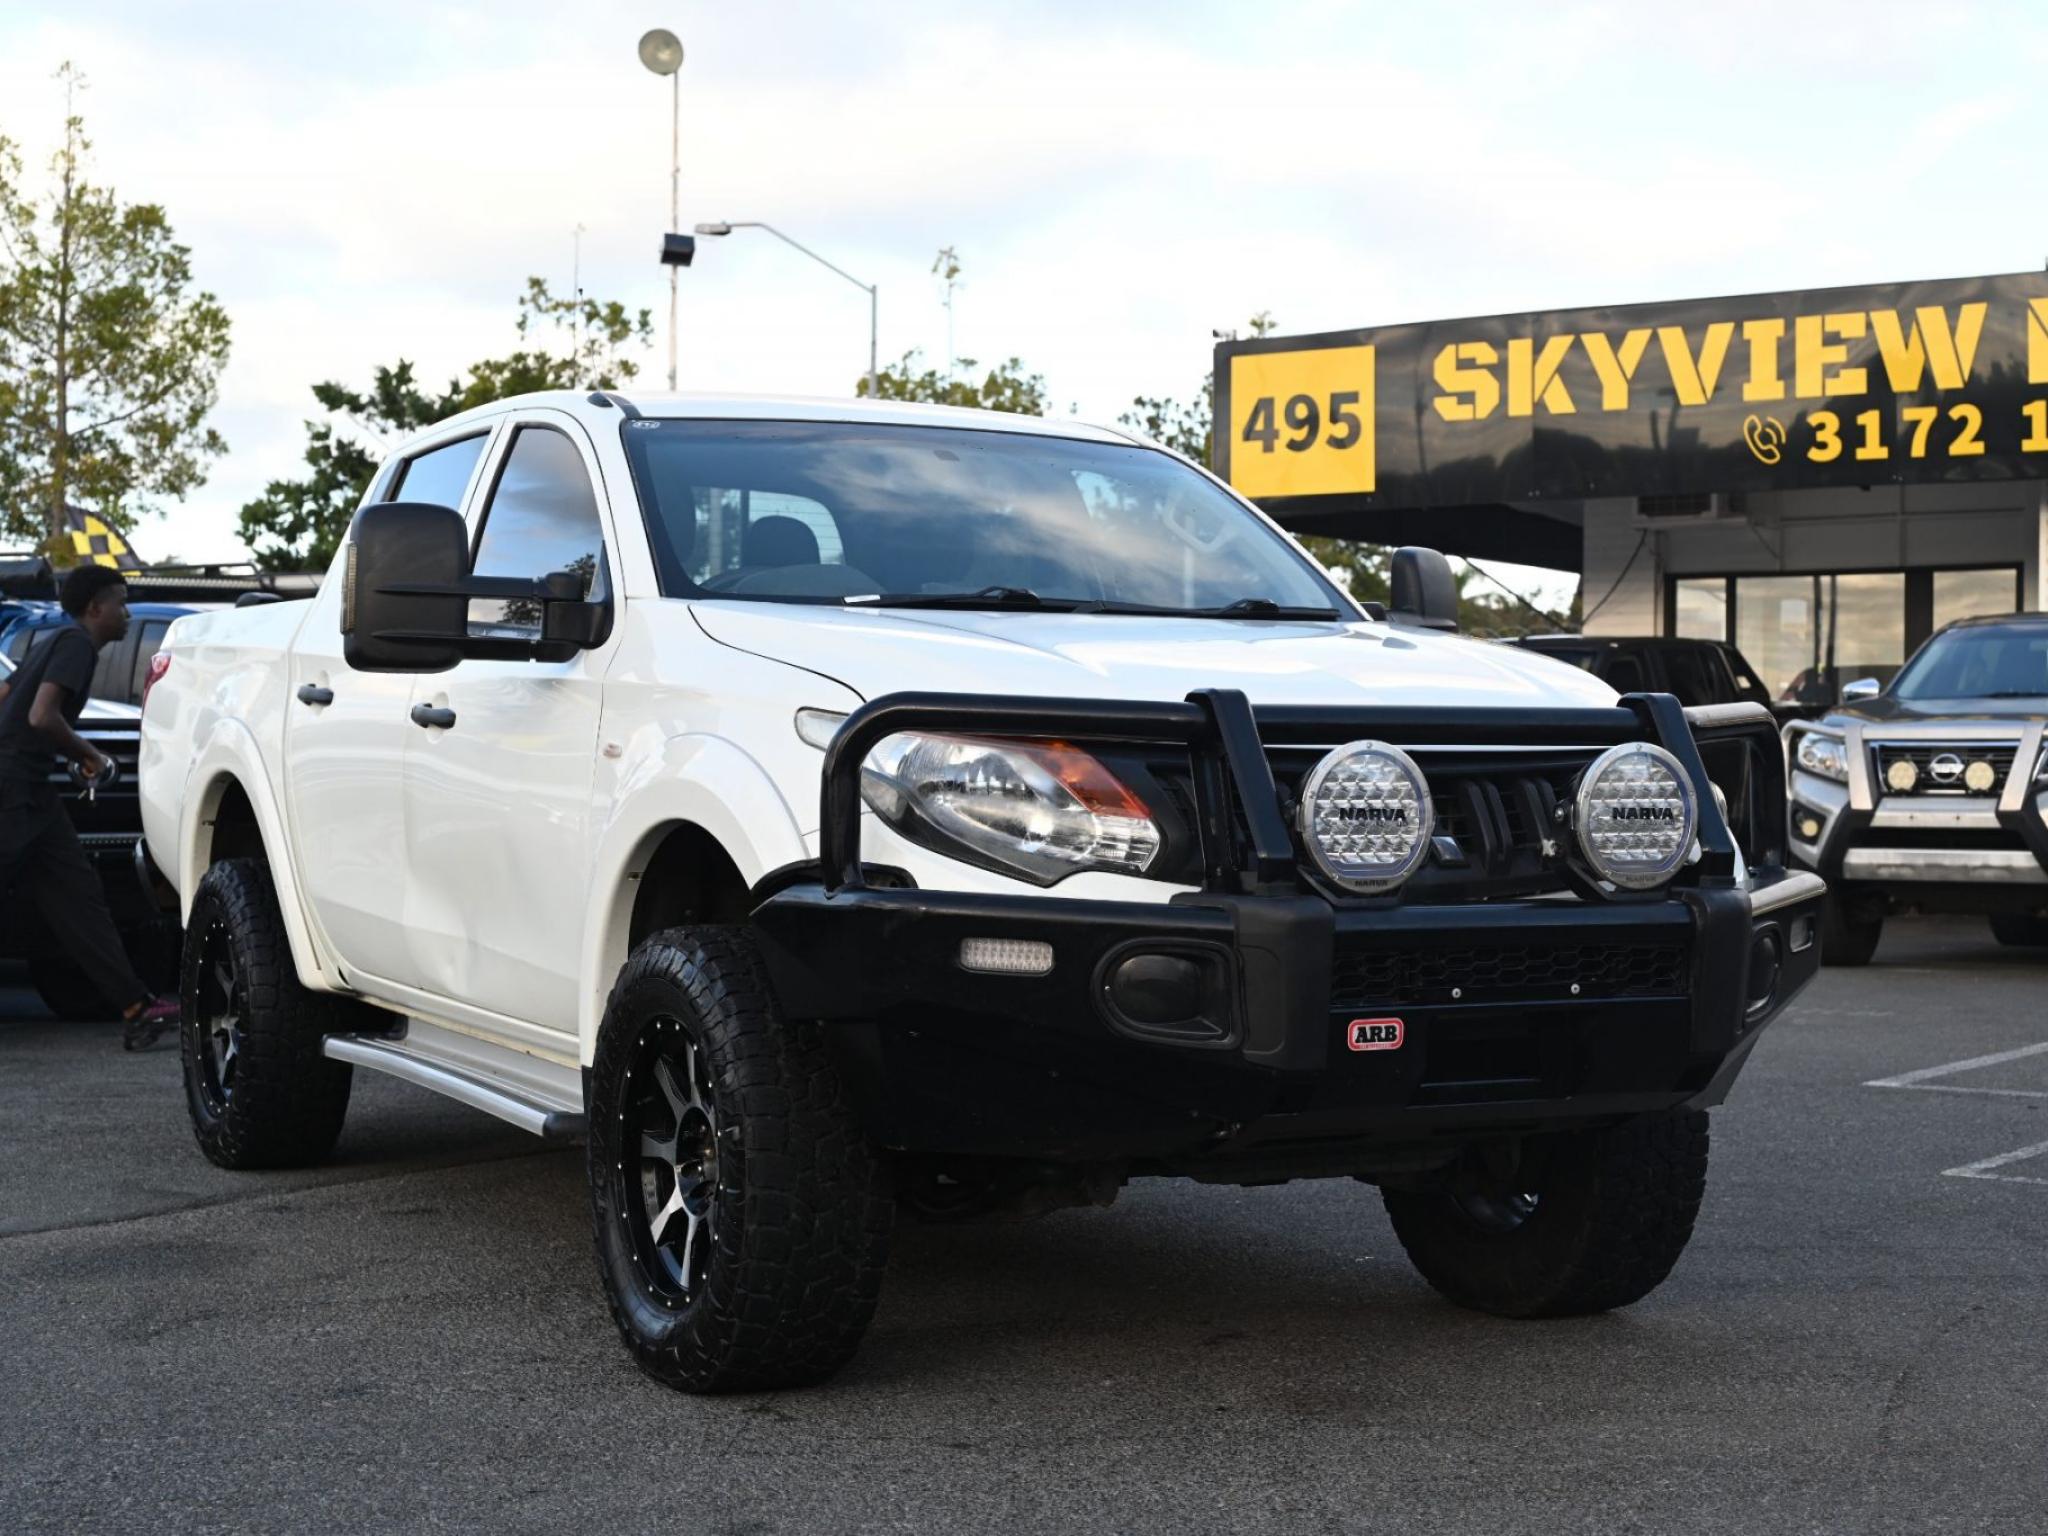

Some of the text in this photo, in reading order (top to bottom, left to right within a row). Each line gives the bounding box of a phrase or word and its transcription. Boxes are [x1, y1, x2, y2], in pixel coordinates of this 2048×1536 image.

[1432, 301, 1989, 422] SKYVIEW
[1242, 390, 1362, 453] 495
[1807, 403, 1986, 462] 3172
[1339, 808, 1406, 820] NARVA
[1612, 807, 1674, 820] NARVA
[1355, 1025, 1398, 1044] ARB
